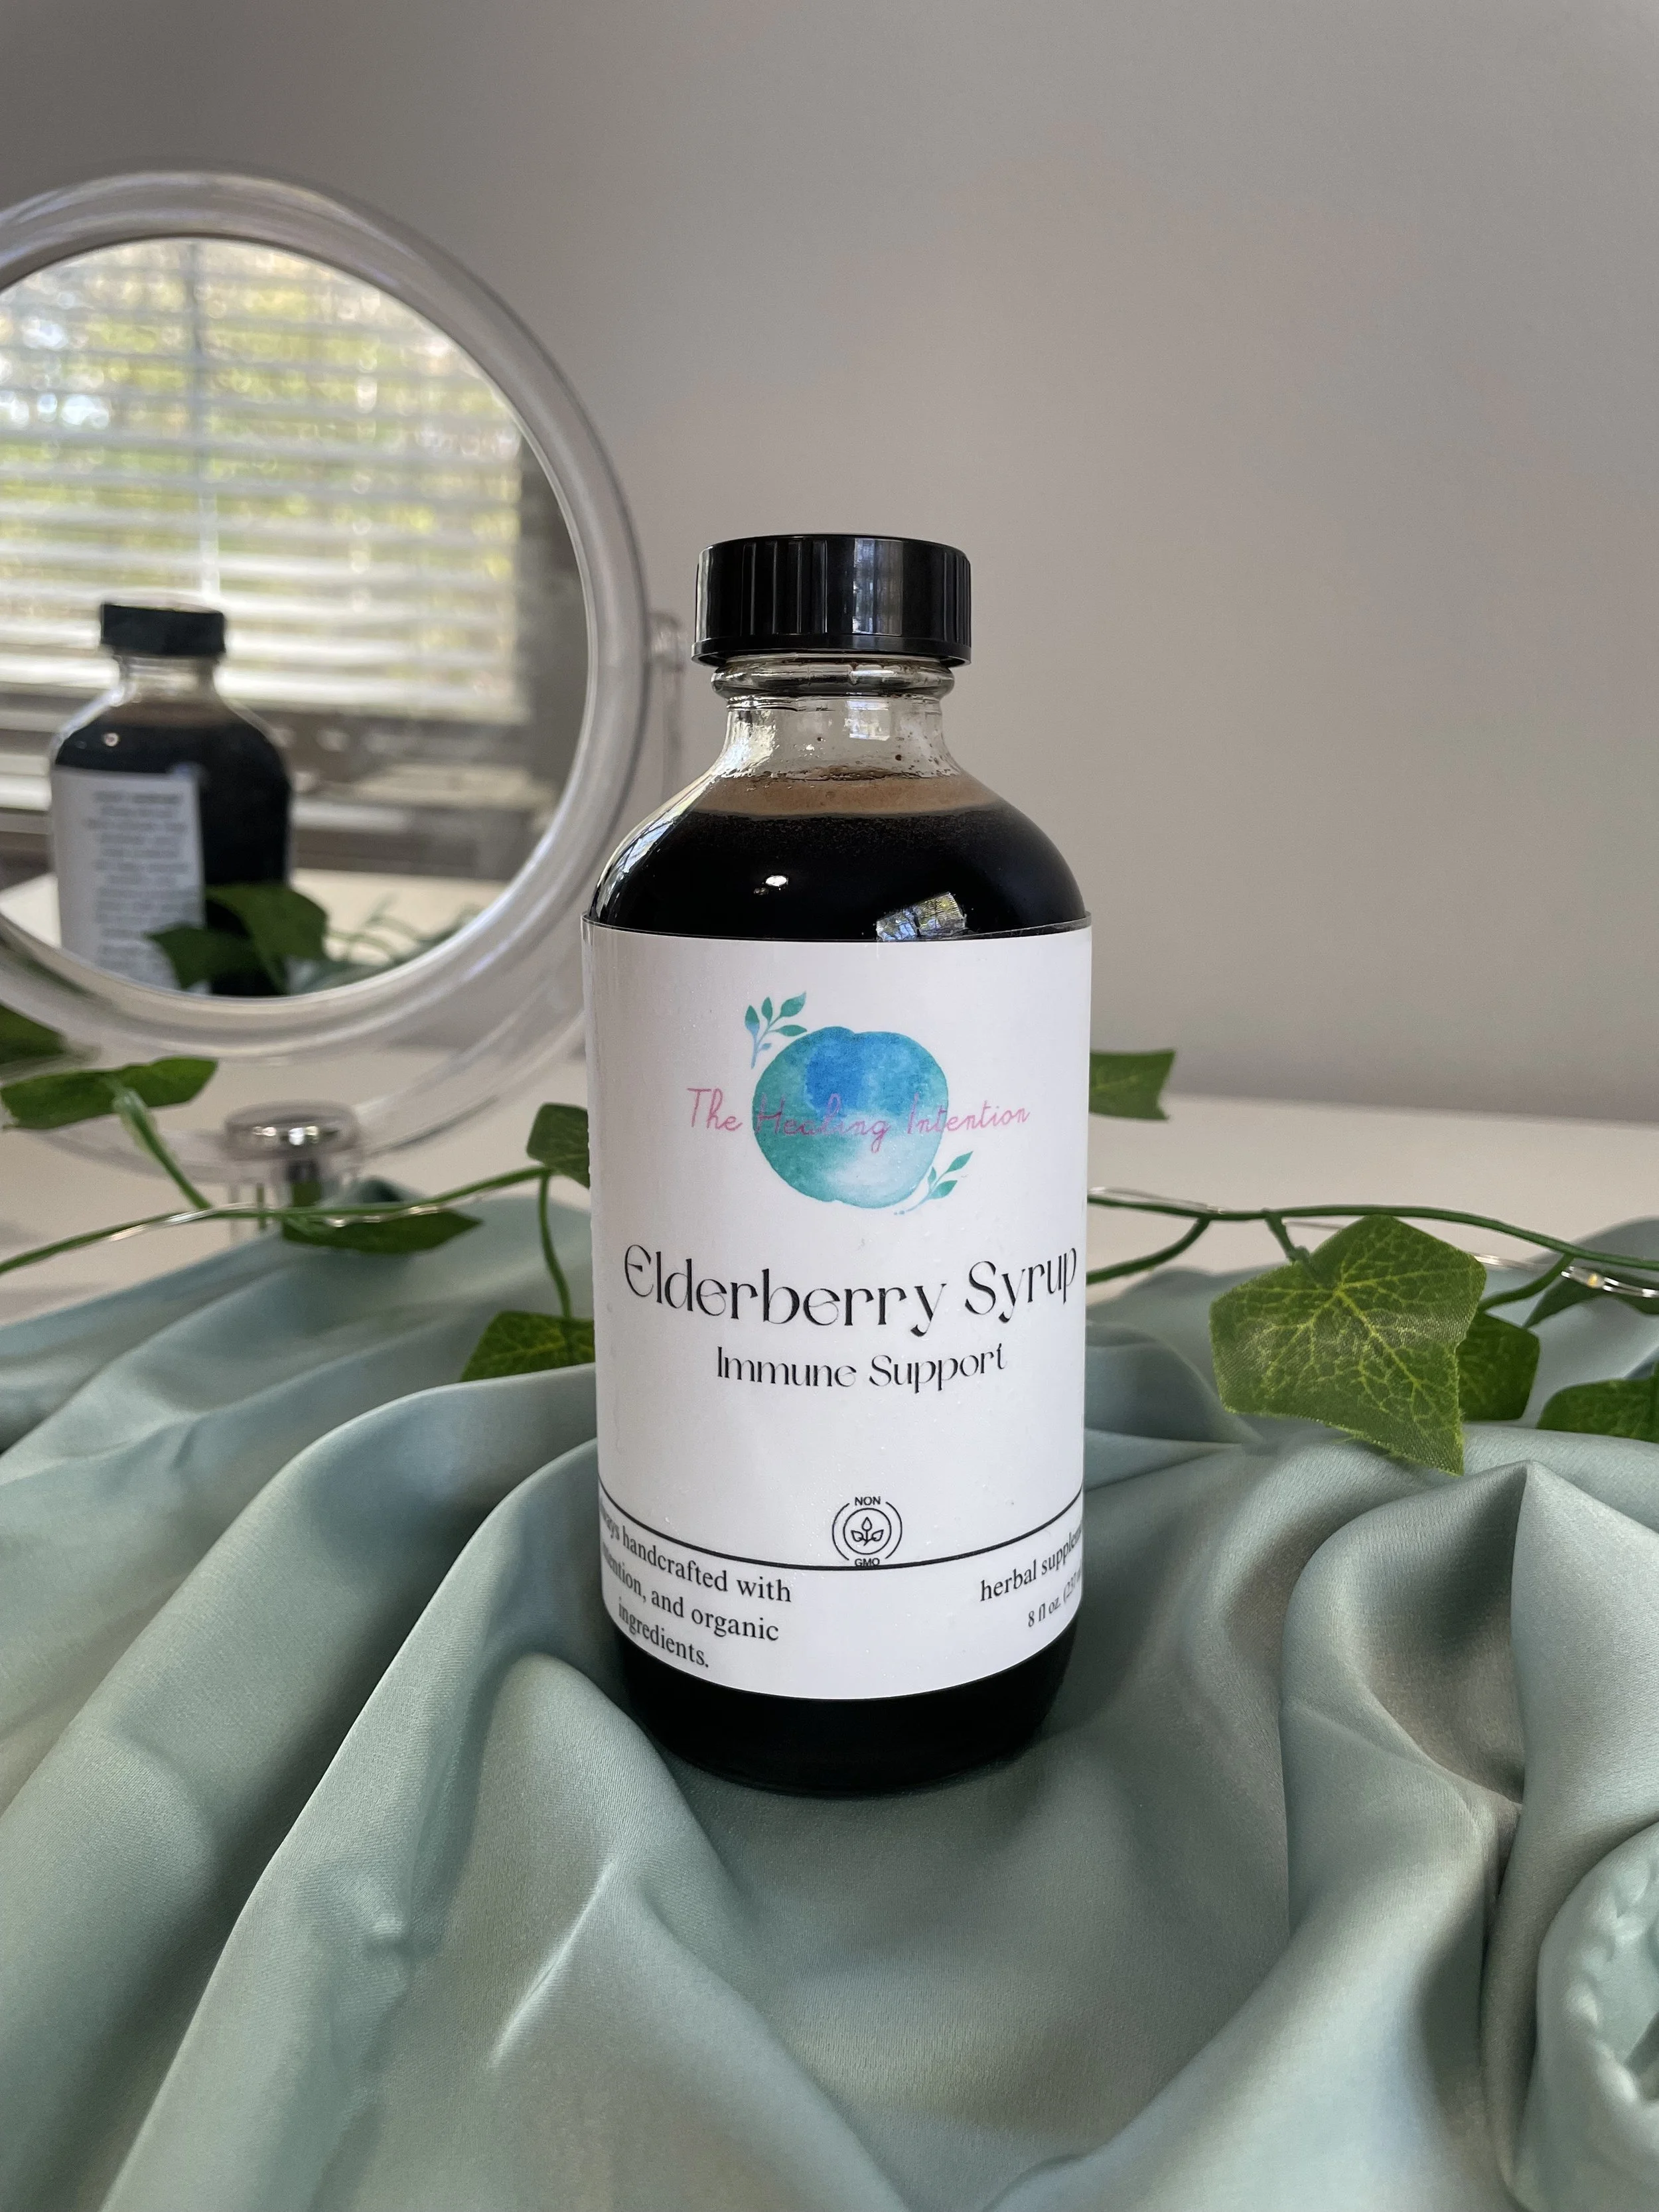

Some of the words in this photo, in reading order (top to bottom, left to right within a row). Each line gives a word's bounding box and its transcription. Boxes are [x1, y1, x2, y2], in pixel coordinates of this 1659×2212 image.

[686, 1087, 743, 1131] The
[755, 1092, 892, 1153] Healing
[907, 1092, 1031, 1135] Intention
[624, 1244, 948, 1338] Elderberry
[964, 1247, 1077, 1324] Syrup
[717, 1346, 857, 1388] Immune
[869, 1342, 1007, 1394] Support
[854, 1495, 881, 1507] NON
[622, 1525, 729, 1593] handcrafted
[736, 1576, 792, 1603] with
[854, 1557, 881, 1567] GMO
[979, 1558, 1038, 1603] herbal
[618, 1595, 709, 1668] ingredients.
[650, 1589, 685, 1619] and
[691, 1607, 780, 1642] organic
[1028, 1610, 1035, 1628] 8
[1048, 1597, 1061, 1615] oz
